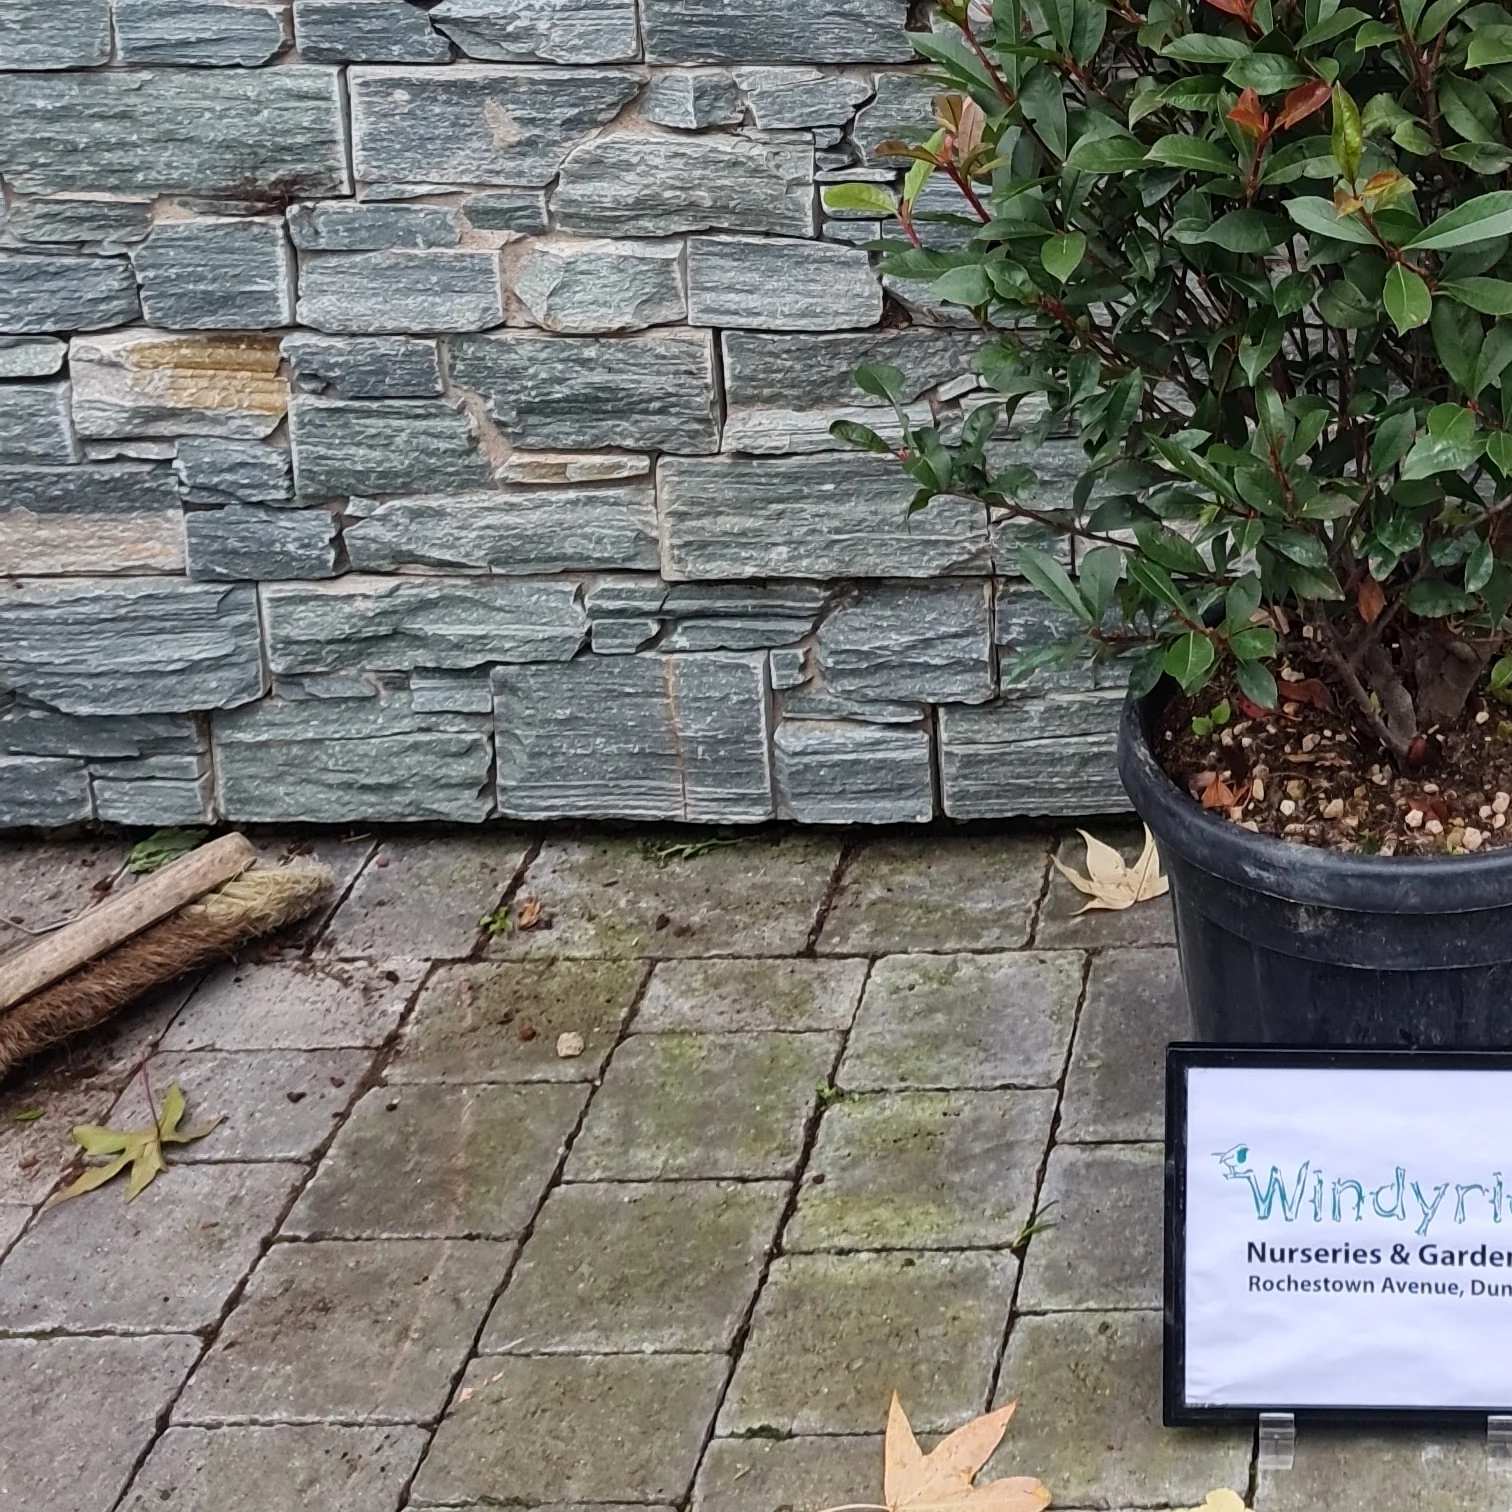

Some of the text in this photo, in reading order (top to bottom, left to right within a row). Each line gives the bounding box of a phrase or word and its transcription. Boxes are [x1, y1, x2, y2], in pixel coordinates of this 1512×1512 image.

[1246, 1240, 1383, 1266] Nurseries
[1389, 1242, 1411, 1266] &
[1247, 1273, 1376, 1294] Rochestown
[1380, 1275, 1465, 1299] Avenue,
